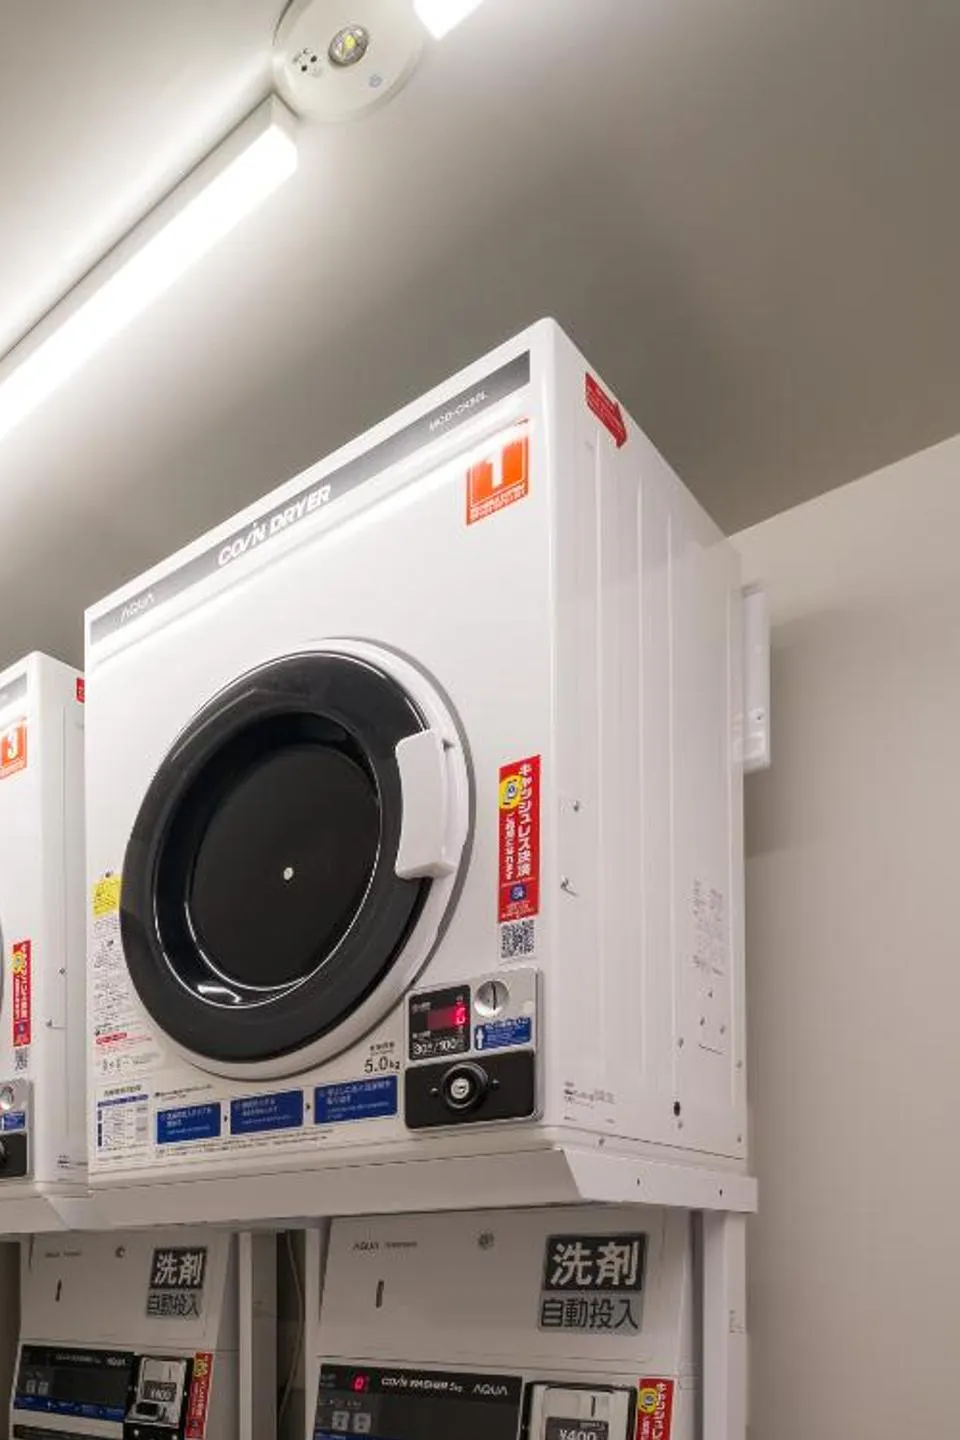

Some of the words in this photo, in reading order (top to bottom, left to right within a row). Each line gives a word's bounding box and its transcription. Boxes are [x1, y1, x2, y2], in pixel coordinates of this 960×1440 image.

[485, 441, 505, 489] 1
[218, 521, 269, 567] COIN
[267, 484, 332, 537] DRYER
[155, 1252, 203, 1285] 洗剤
[550, 1241, 640, 1286] 洗剤
[540, 1299, 639, 1330] 自動投入
[473, 1383, 508, 1396] AQUA
